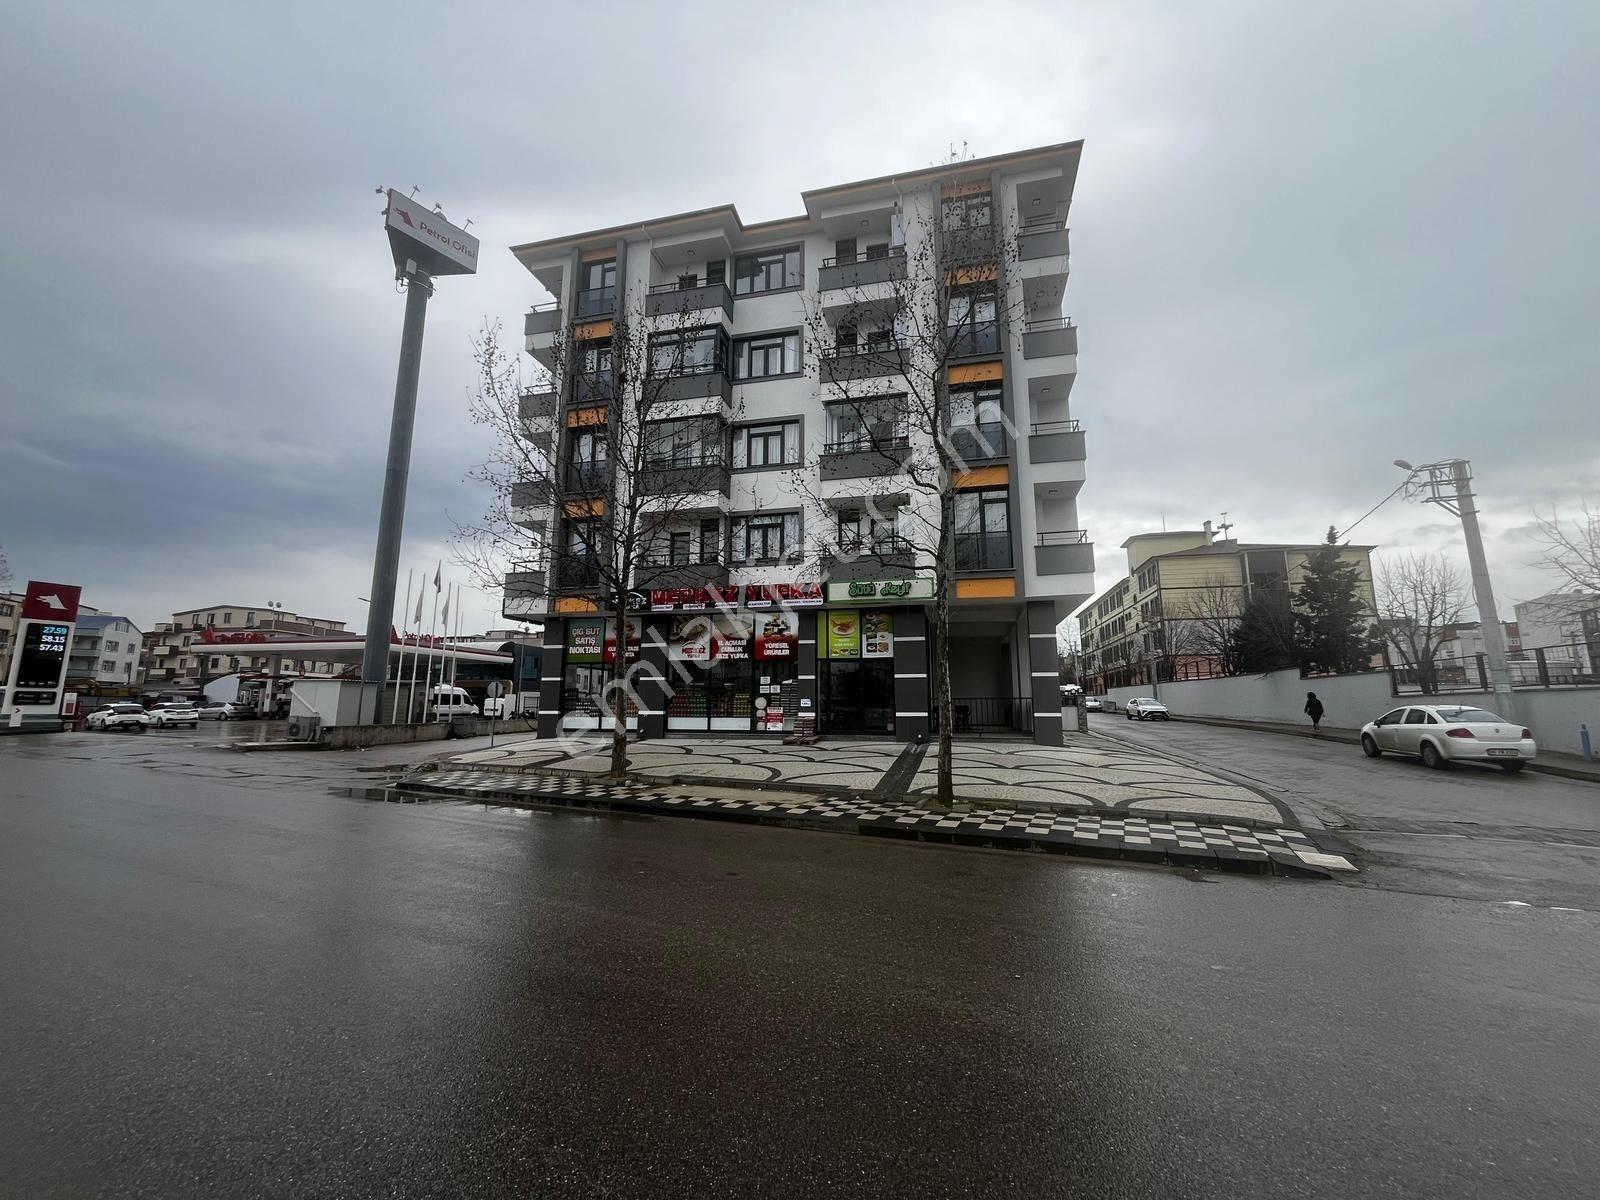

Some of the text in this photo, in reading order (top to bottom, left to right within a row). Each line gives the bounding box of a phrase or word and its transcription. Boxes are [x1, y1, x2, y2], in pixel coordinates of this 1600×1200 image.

[420, 222, 450, 246] Petrol
[651, 585, 739, 605] MERKEZ
[745, 582, 824, 601] YUFKA
[569, 646, 601, 654] NOKTASI
